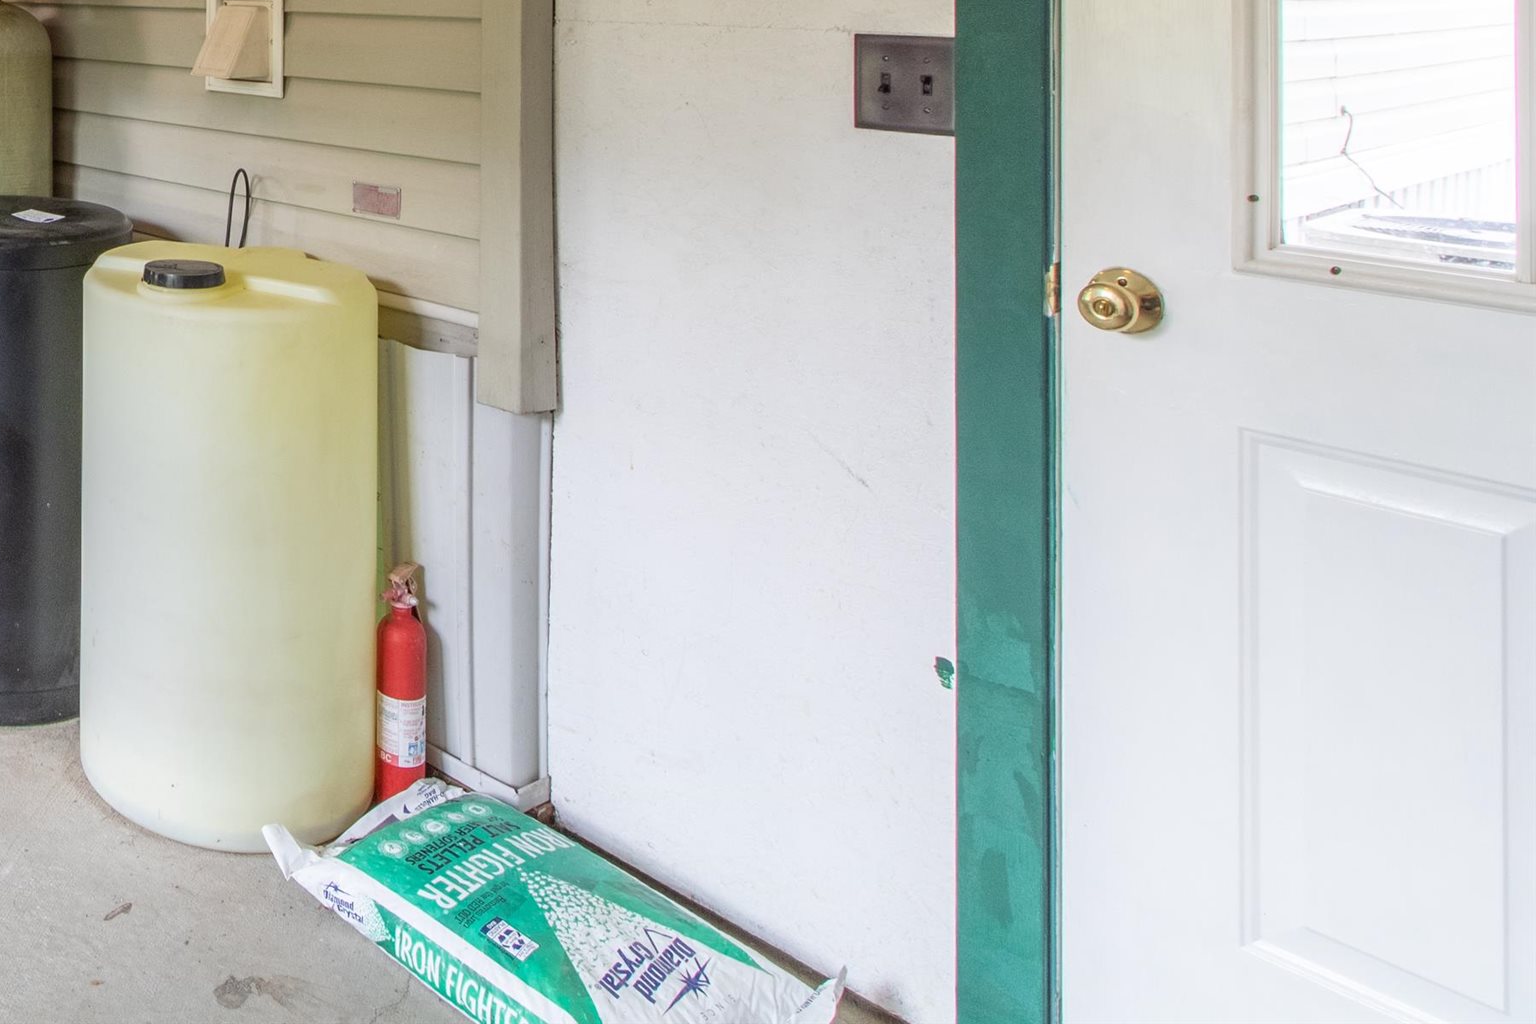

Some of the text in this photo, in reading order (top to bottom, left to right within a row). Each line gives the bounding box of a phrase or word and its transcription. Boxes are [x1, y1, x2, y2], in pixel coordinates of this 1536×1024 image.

[405, 833, 454, 866] SOFTENERS
[417, 822, 521, 875] SALT PELLETS
[417, 827, 576, 910] IRON FIGHTER
[337, 905, 364, 924] Crystal
[454, 909, 471, 925] OUT
[468, 895, 485, 912] RED
[394, 924, 441, 988] IRON
[598, 940, 655, 1000] Crystal
[632, 937, 696, 1005] Diamond
